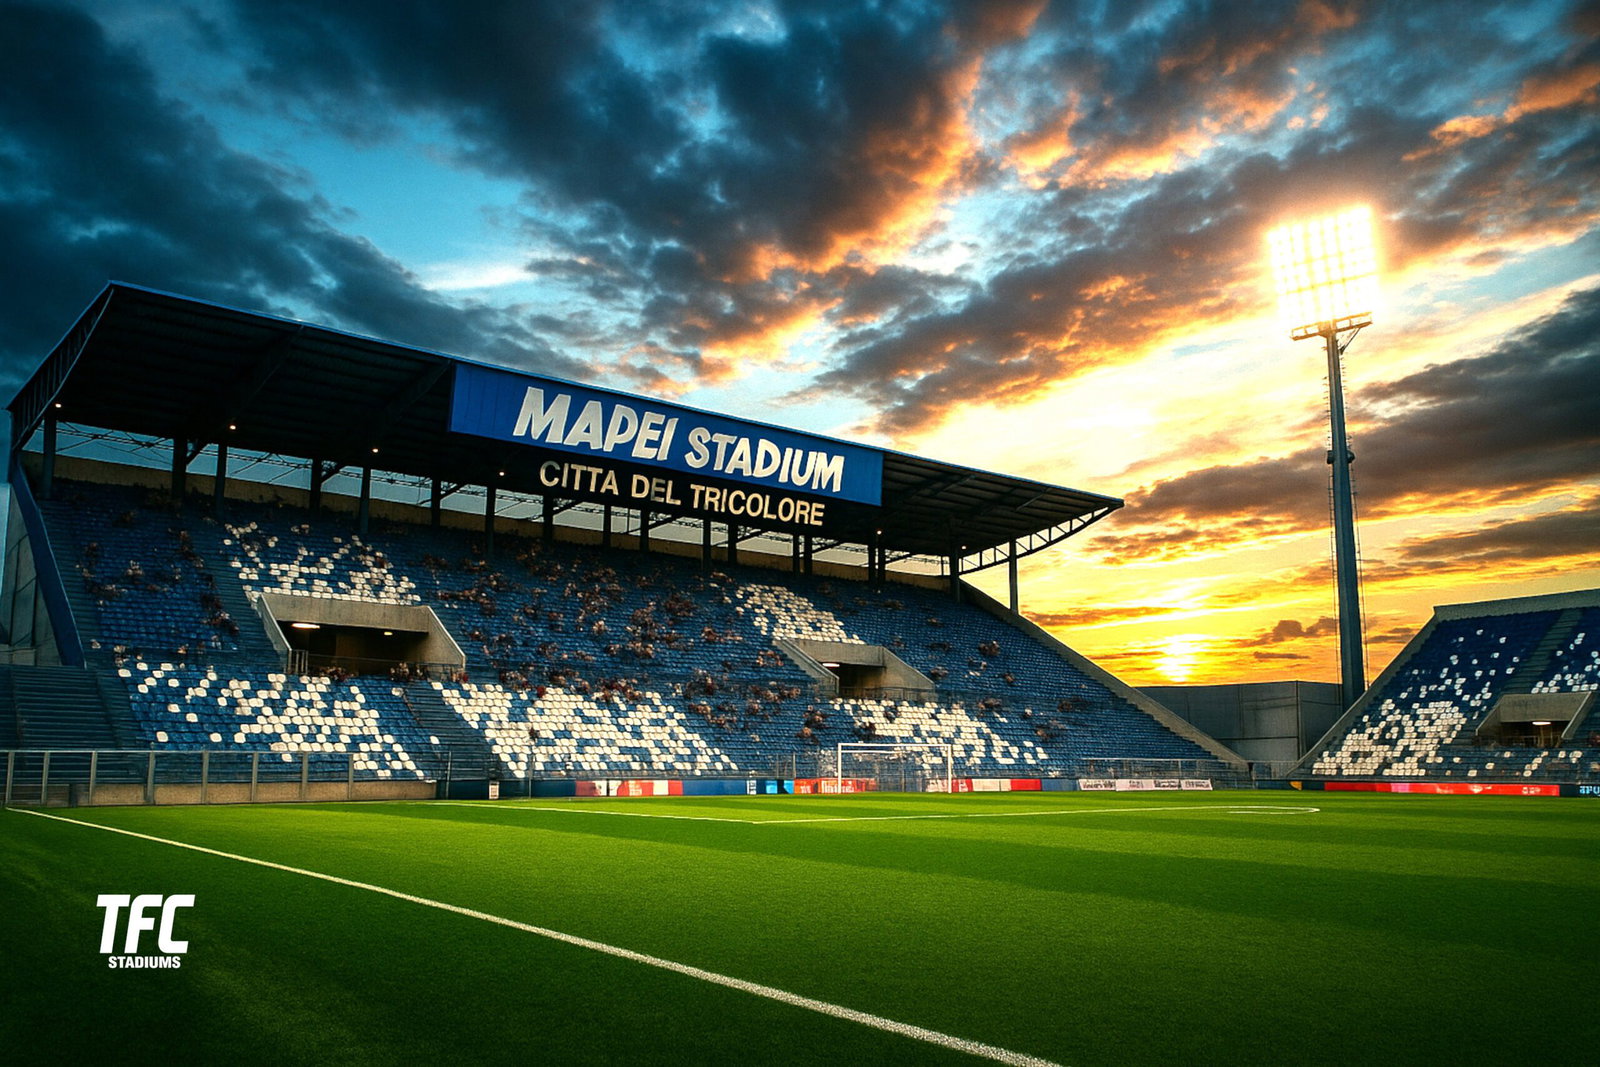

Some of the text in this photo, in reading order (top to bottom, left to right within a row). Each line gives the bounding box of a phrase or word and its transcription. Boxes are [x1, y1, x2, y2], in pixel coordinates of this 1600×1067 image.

[513, 386, 846, 493] MAPEI STADIUM
[539, 460, 826, 527] CITTA DEL TRICOLORE
